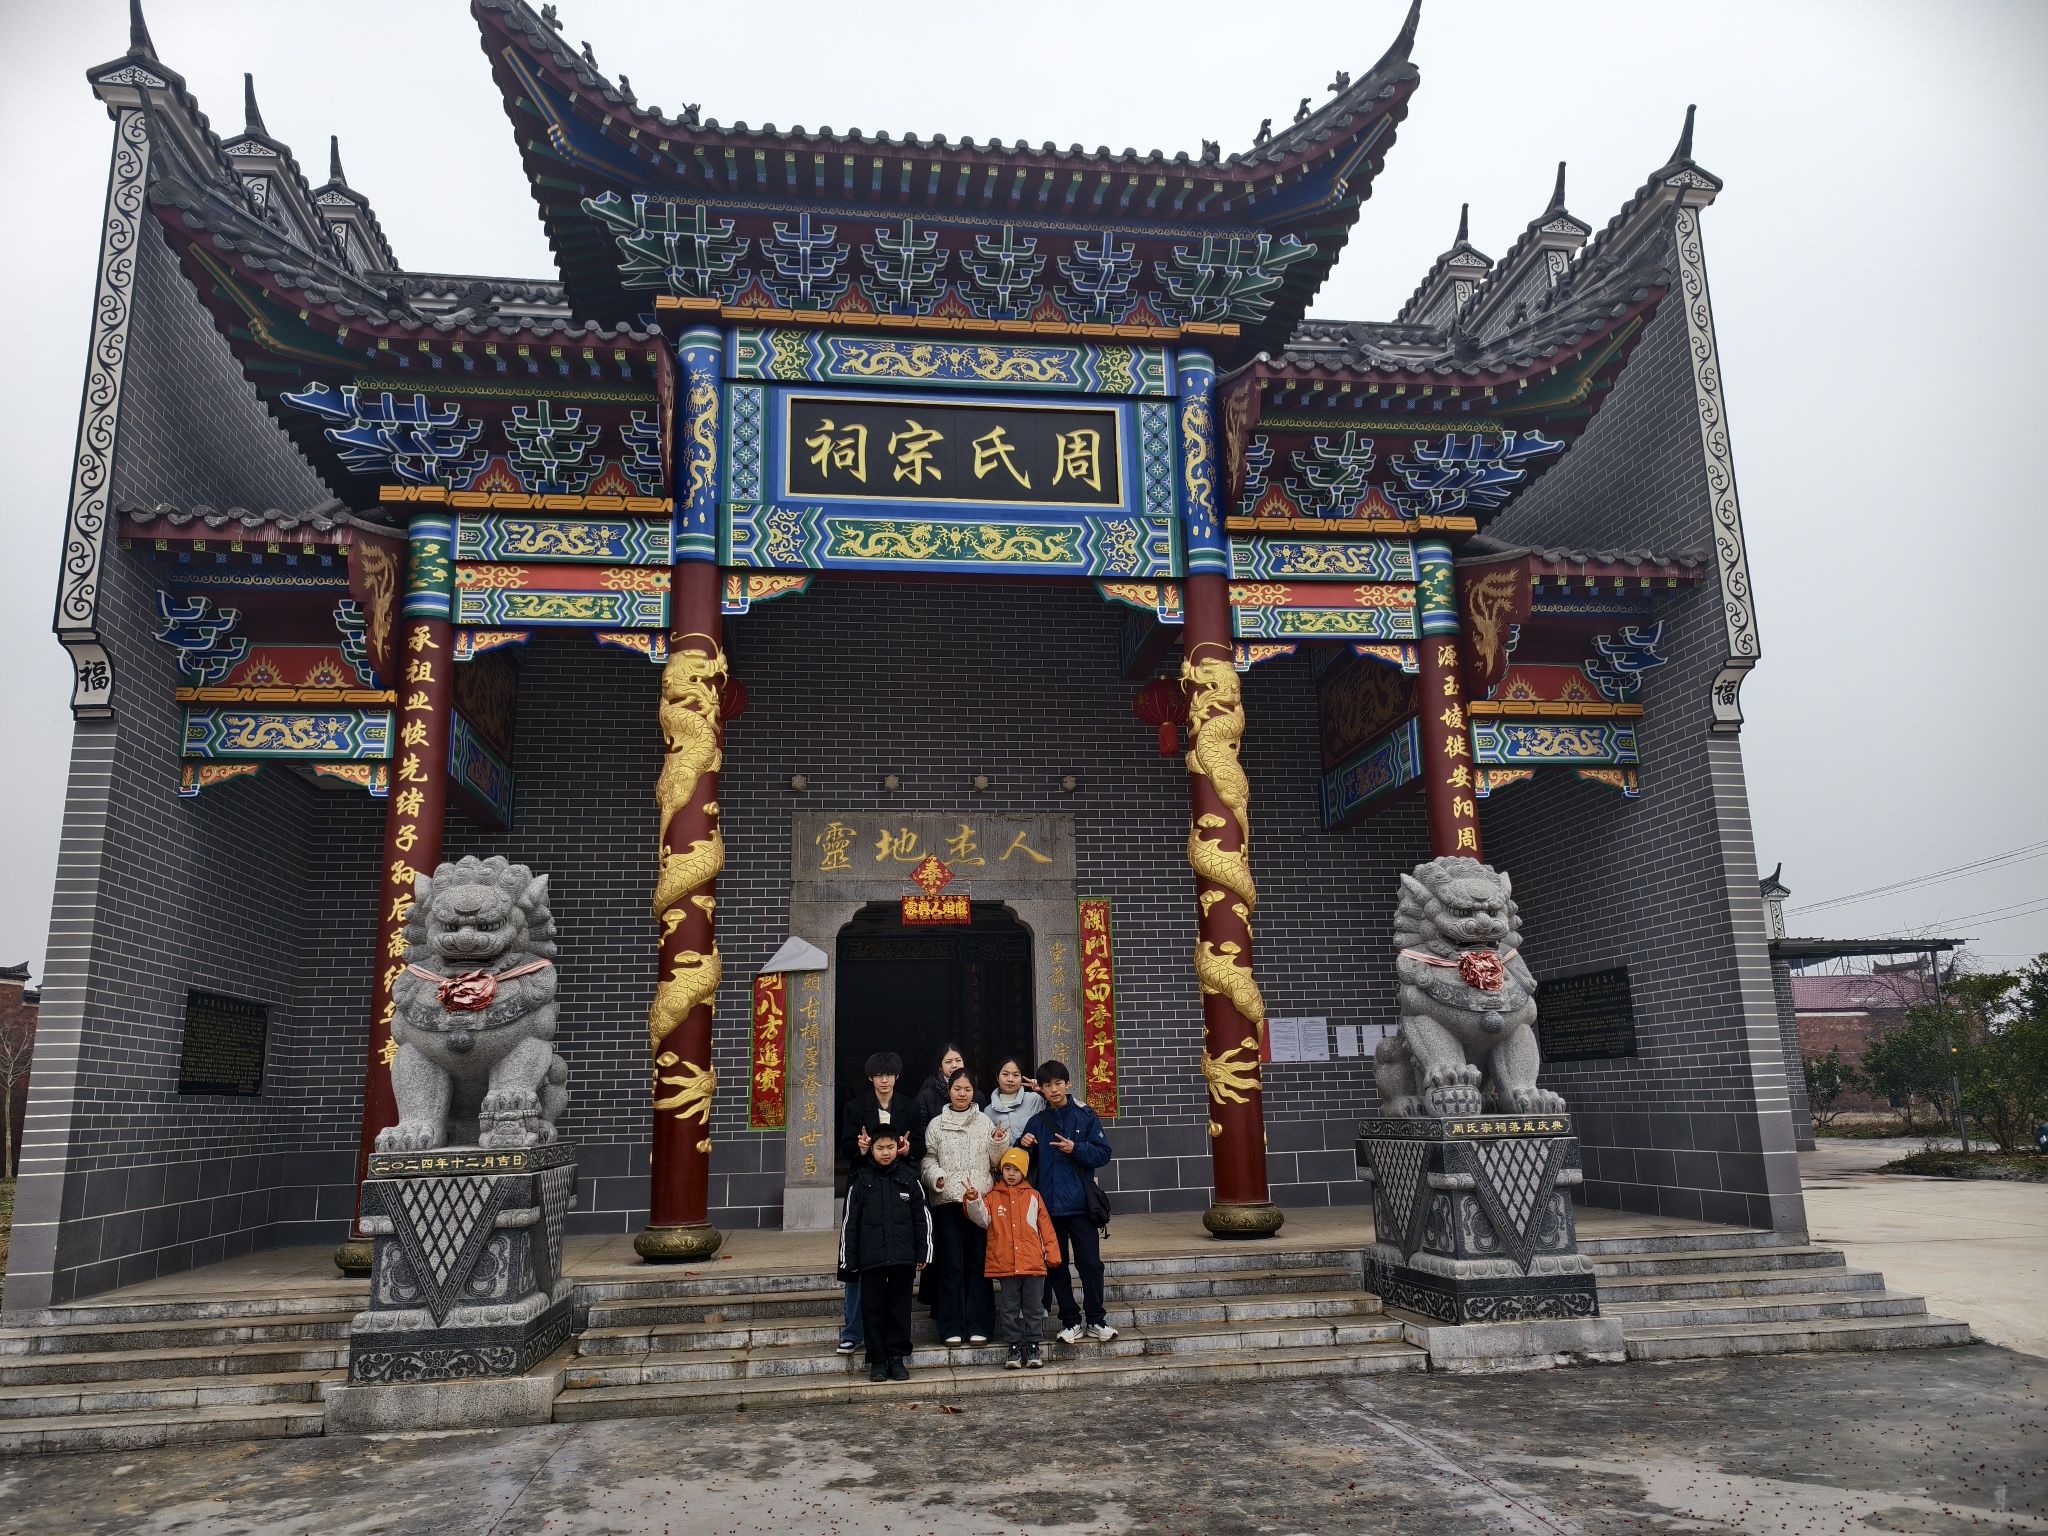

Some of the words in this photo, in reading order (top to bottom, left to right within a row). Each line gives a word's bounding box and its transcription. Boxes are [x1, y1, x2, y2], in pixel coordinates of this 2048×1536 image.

[805, 418, 1102, 492] 周氏宗祠
[79, 660, 110, 692] 福
[1713, 679, 1737, 706] 福
[1452, 1120, 1564, 1135] 周氏宗祠落成庆典
